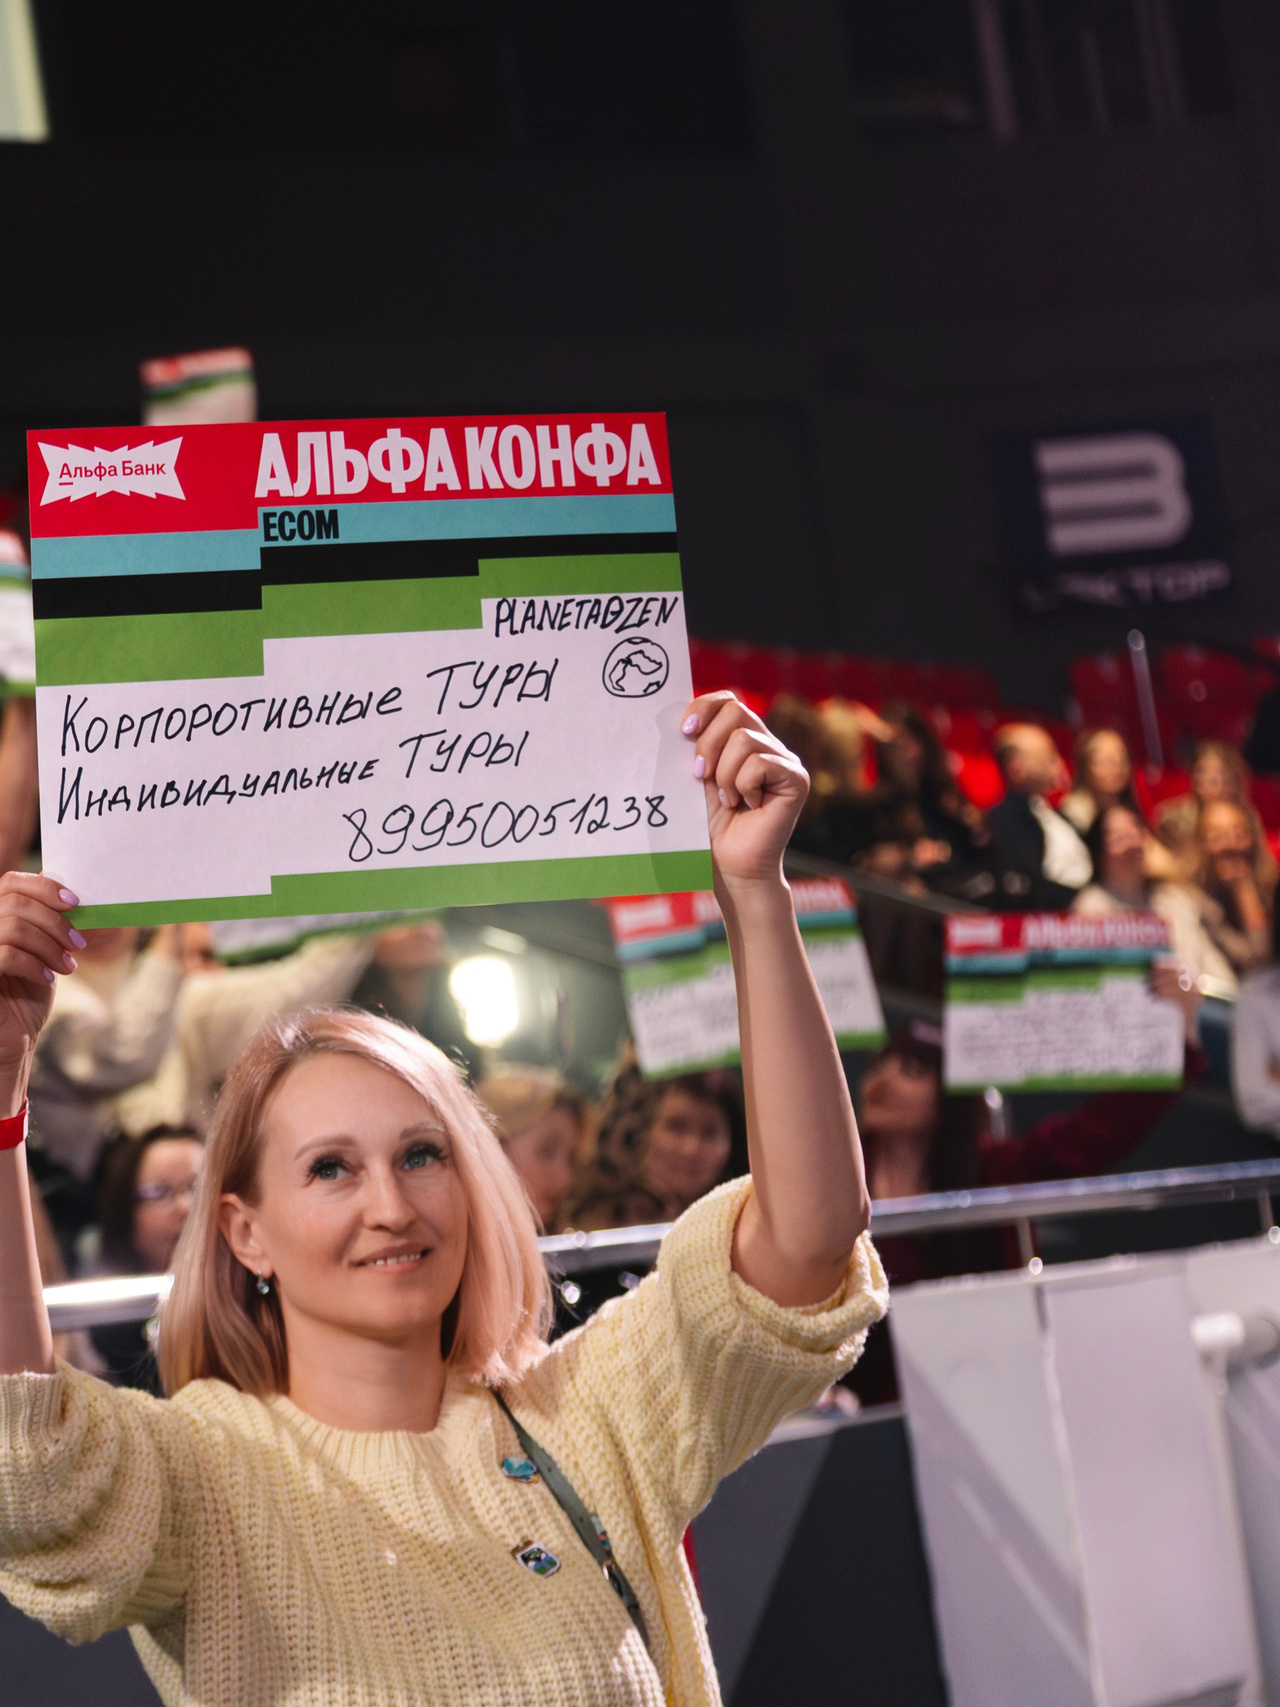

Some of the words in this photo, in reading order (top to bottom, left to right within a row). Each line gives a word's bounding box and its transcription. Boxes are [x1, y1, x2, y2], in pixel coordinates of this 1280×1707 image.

[59, 461, 118, 486] Альфа
[121, 460, 167, 476] Банк
[254, 428, 461, 498] АЛЬФА
[464, 423, 662, 490] КОНФА
[263, 509, 339, 542] ECOM
[426, 658, 559, 715] ТУРЫ
[399, 730, 529, 778] ТУРЫ
[342, 793, 669, 862] 89950051238
